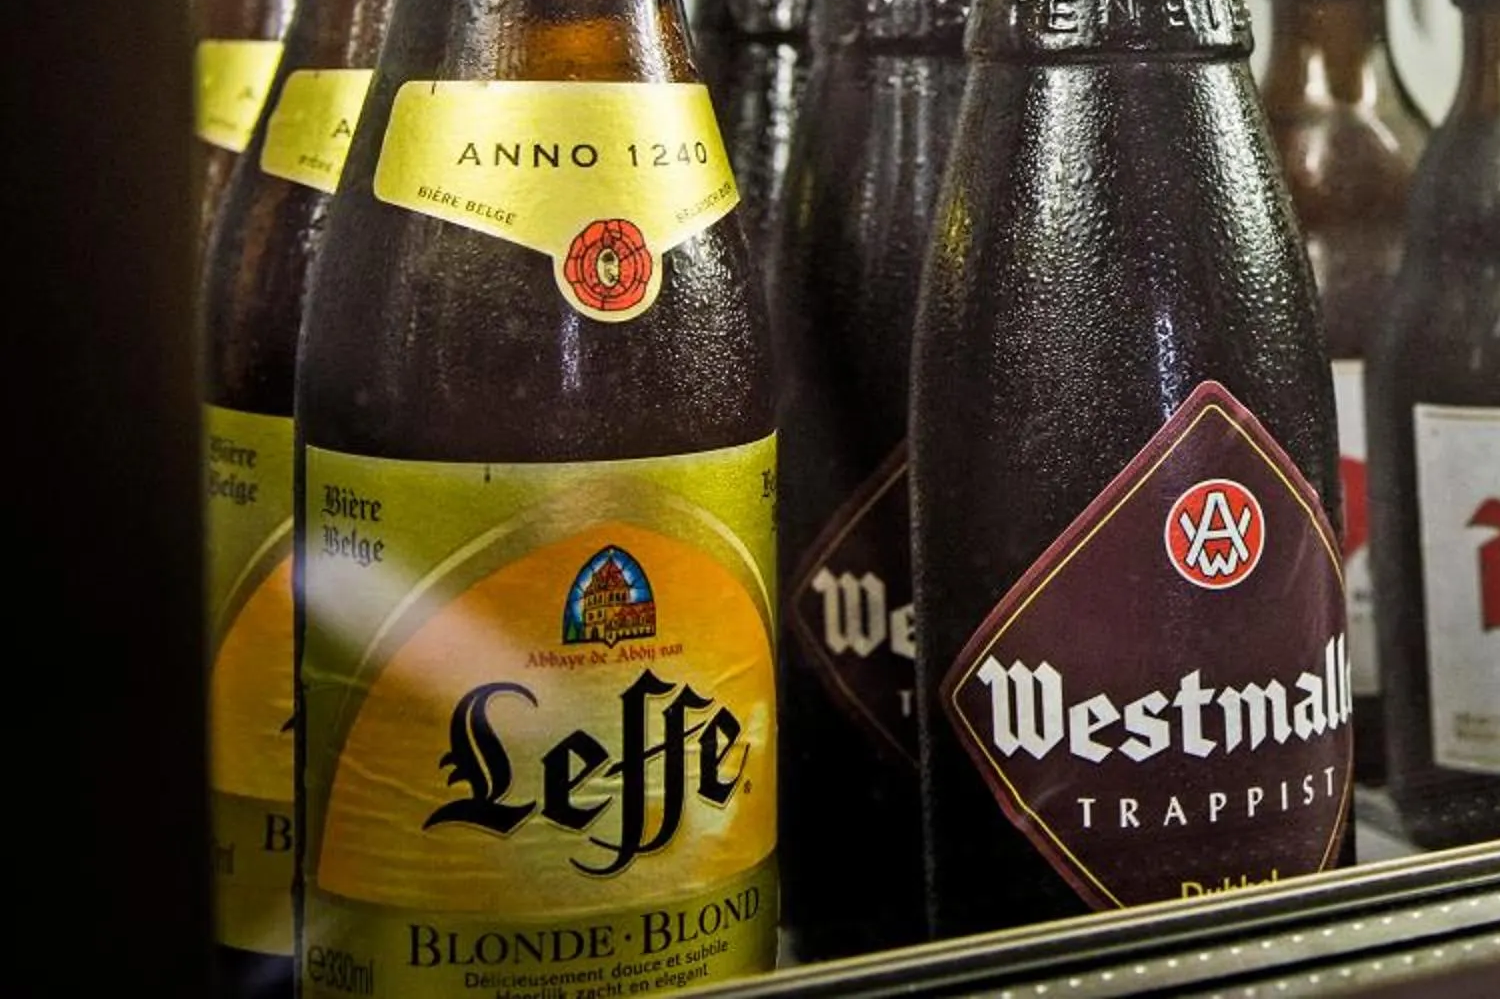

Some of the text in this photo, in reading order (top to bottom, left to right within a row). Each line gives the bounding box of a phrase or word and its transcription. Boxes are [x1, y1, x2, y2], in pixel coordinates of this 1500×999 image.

[457, 141, 708, 168] ANNO 1240
[417, 185, 518, 227] BIÈRE BELGE
[321, 484, 383, 522] Bière
[322, 523, 385, 568] Belge
[421, 667, 751, 879] Leffe
[1077, 766, 1337, 829] TRAPPIST
[407, 886, 761, 969] BLONDE BLOND
[611, 957, 663, 979] douce
[667, 954, 682, 968] et
[685, 939, 729, 963] subtile
[629, 980, 650, 995] en
[655, 963, 709, 990] elegant
